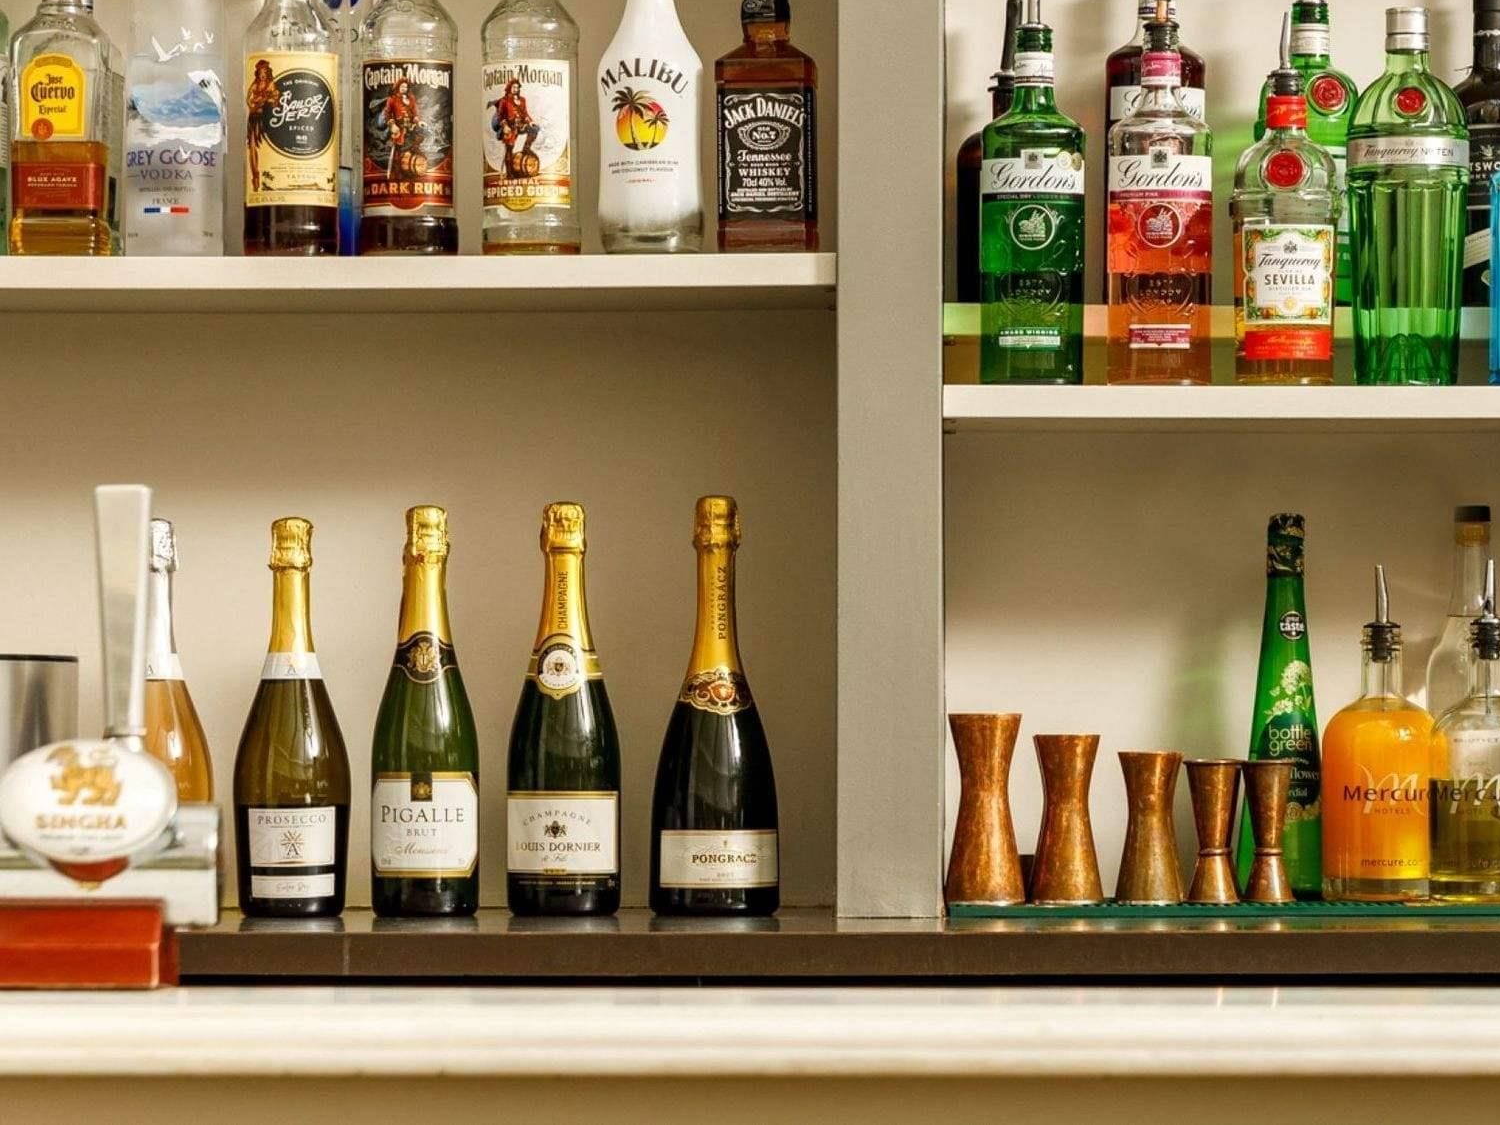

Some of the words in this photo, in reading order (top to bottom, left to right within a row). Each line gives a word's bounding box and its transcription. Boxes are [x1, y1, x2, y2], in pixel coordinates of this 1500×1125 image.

[365, 62, 402, 91] Captain
[404, 64, 450, 89] Morgan
[516, 64, 563, 88] Morgan
[600, 58, 689, 96] MALIBU
[31, 82, 75, 103] Cuervo
[723, 102, 757, 128] JACK
[127, 150, 154, 167] GREY
[160, 149, 216, 167] GOOSE
[737, 149, 792, 162] Tennessee
[1363, 141, 1419, 160] Tanqueray
[140, 168, 193, 181] VODKA
[739, 167, 791, 176] WHISKEY
[990, 160, 1076, 191] Gordon's
[1117, 157, 1205, 189] Gordon's
[372, 181, 409, 195] DARK
[414, 181, 443, 195] RUM
[487, 185, 522, 198] SPICED
[1257, 250, 1321, 270] Tanqueray
[1264, 274, 1316, 287] SEVILLA
[557, 570, 569, 630] CHAMPAGNE
[1269, 725, 1312, 741] bottle
[1270, 740, 1313, 756] green
[257, 815, 327, 825] PROSECCO
[381, 804, 465, 823] PIGALLE
[407, 827, 437, 837] BRUT
[549, 840, 601, 853] DORNIER
